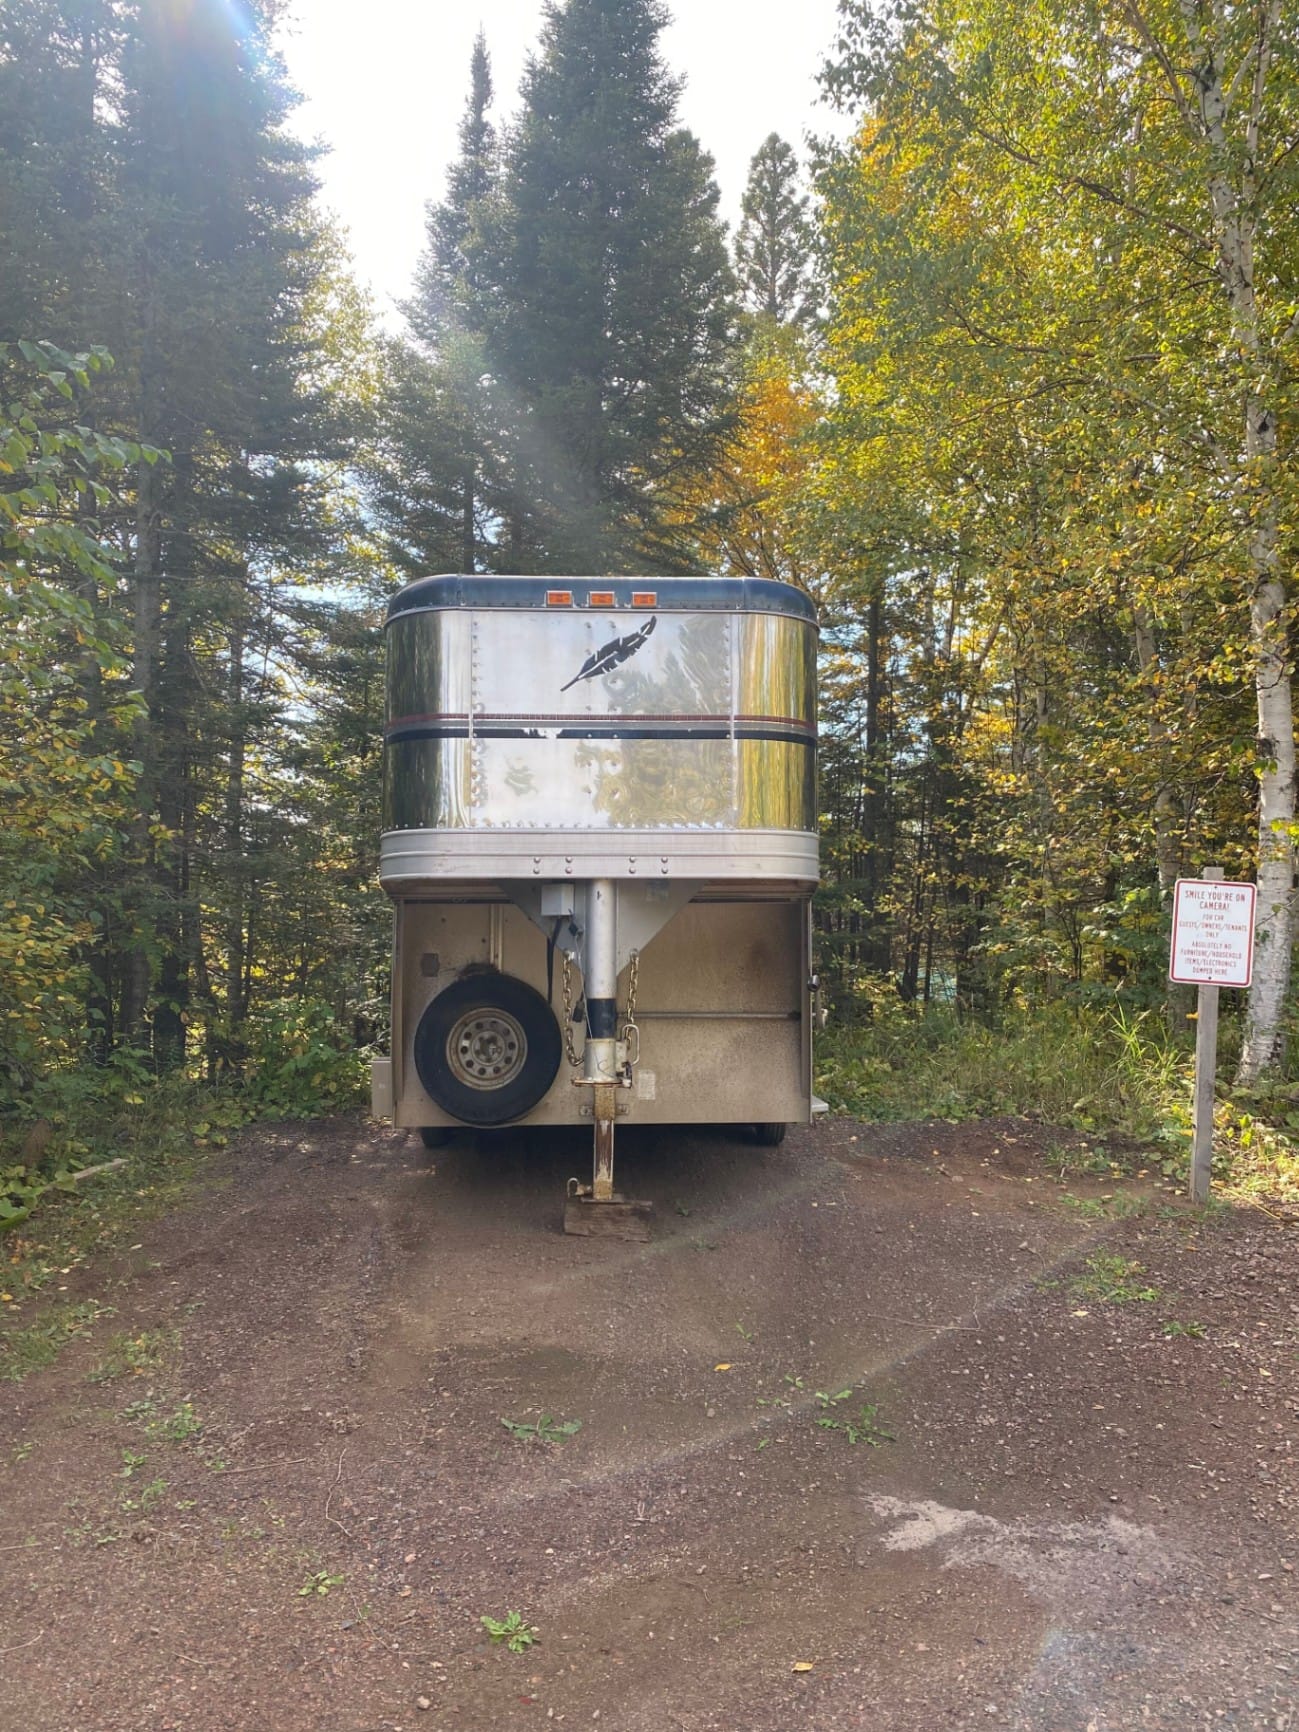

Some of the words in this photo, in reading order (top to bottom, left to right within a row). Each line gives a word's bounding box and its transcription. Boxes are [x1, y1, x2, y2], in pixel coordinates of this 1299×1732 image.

[1185, 890, 1205, 900] SMILE
[1208, 891, 1233, 901] YOU'RE
[1236, 893, 1245, 902] ON
[1199, 901, 1230, 911] CAMERA!
